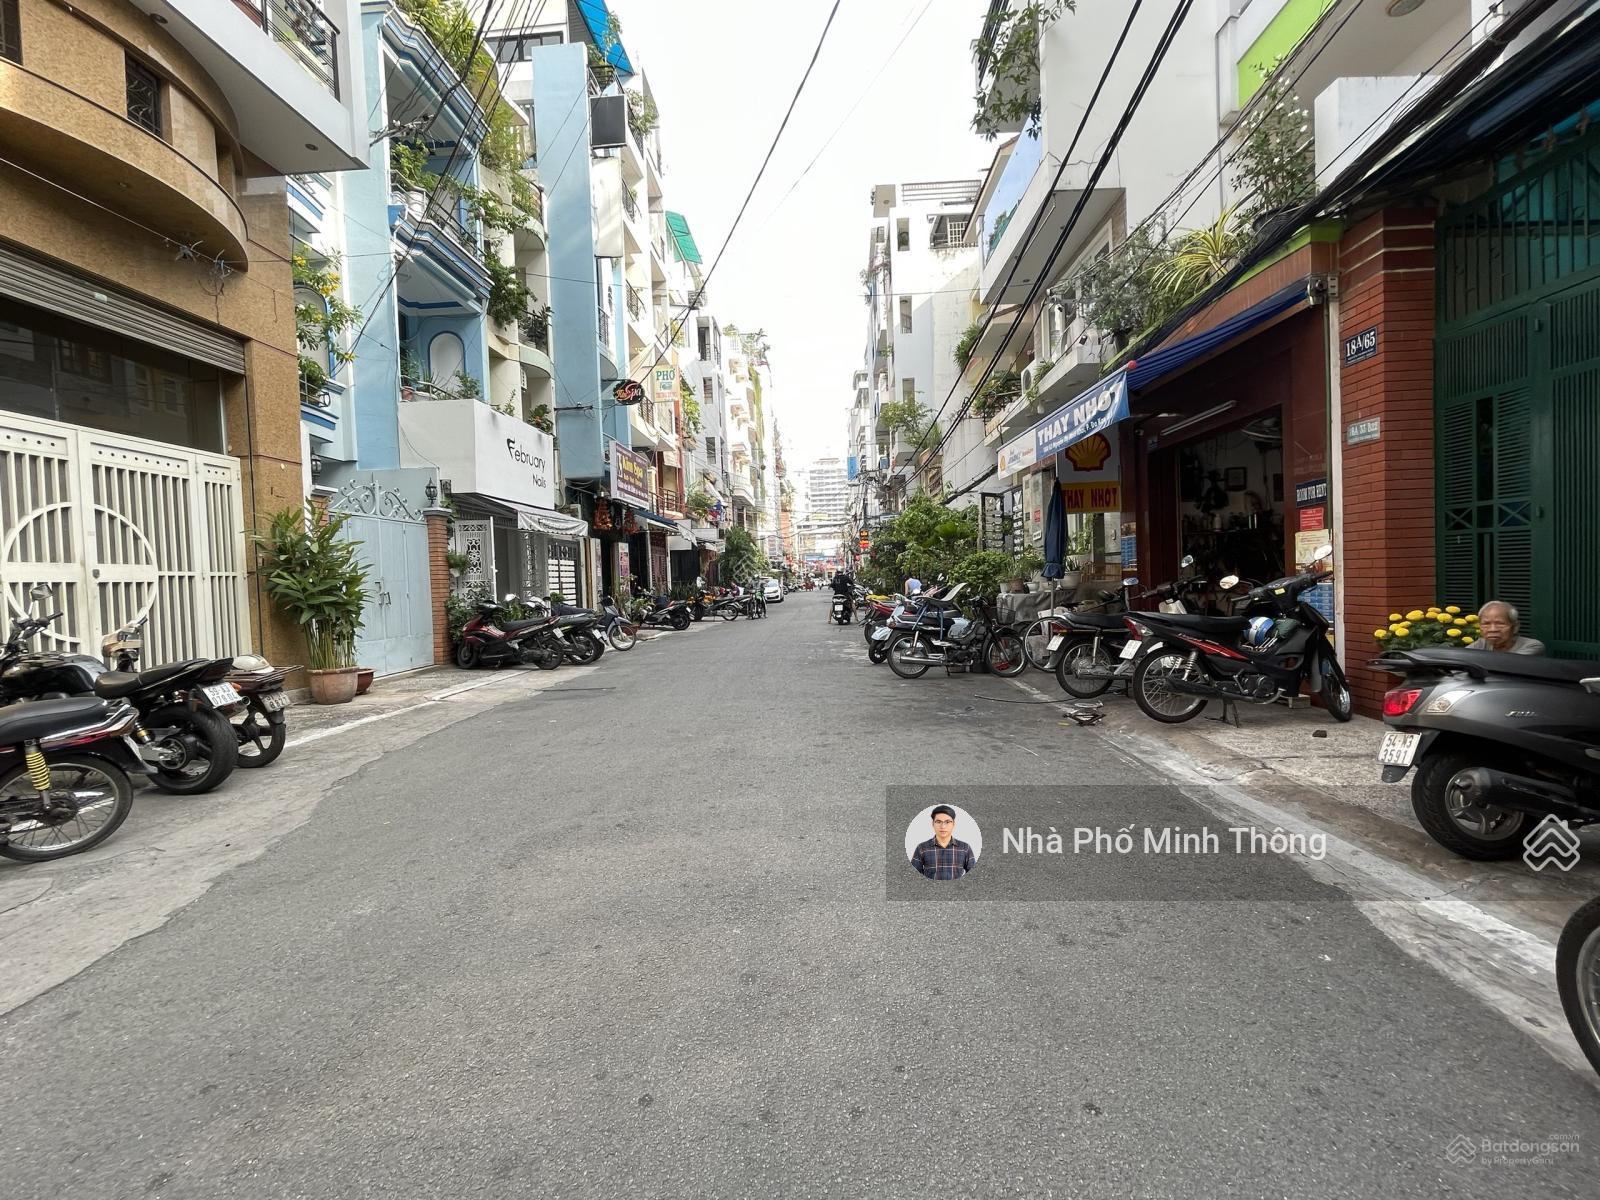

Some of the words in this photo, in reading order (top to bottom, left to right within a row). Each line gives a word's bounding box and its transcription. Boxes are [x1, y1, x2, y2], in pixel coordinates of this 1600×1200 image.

[1346, 330, 1376, 357] 18A/65
[1037, 413, 1070, 446] THAY
[507, 437, 546, 473] February
[532, 474, 547, 488] Nails
[1381, 749, 1407, 763] 3591
